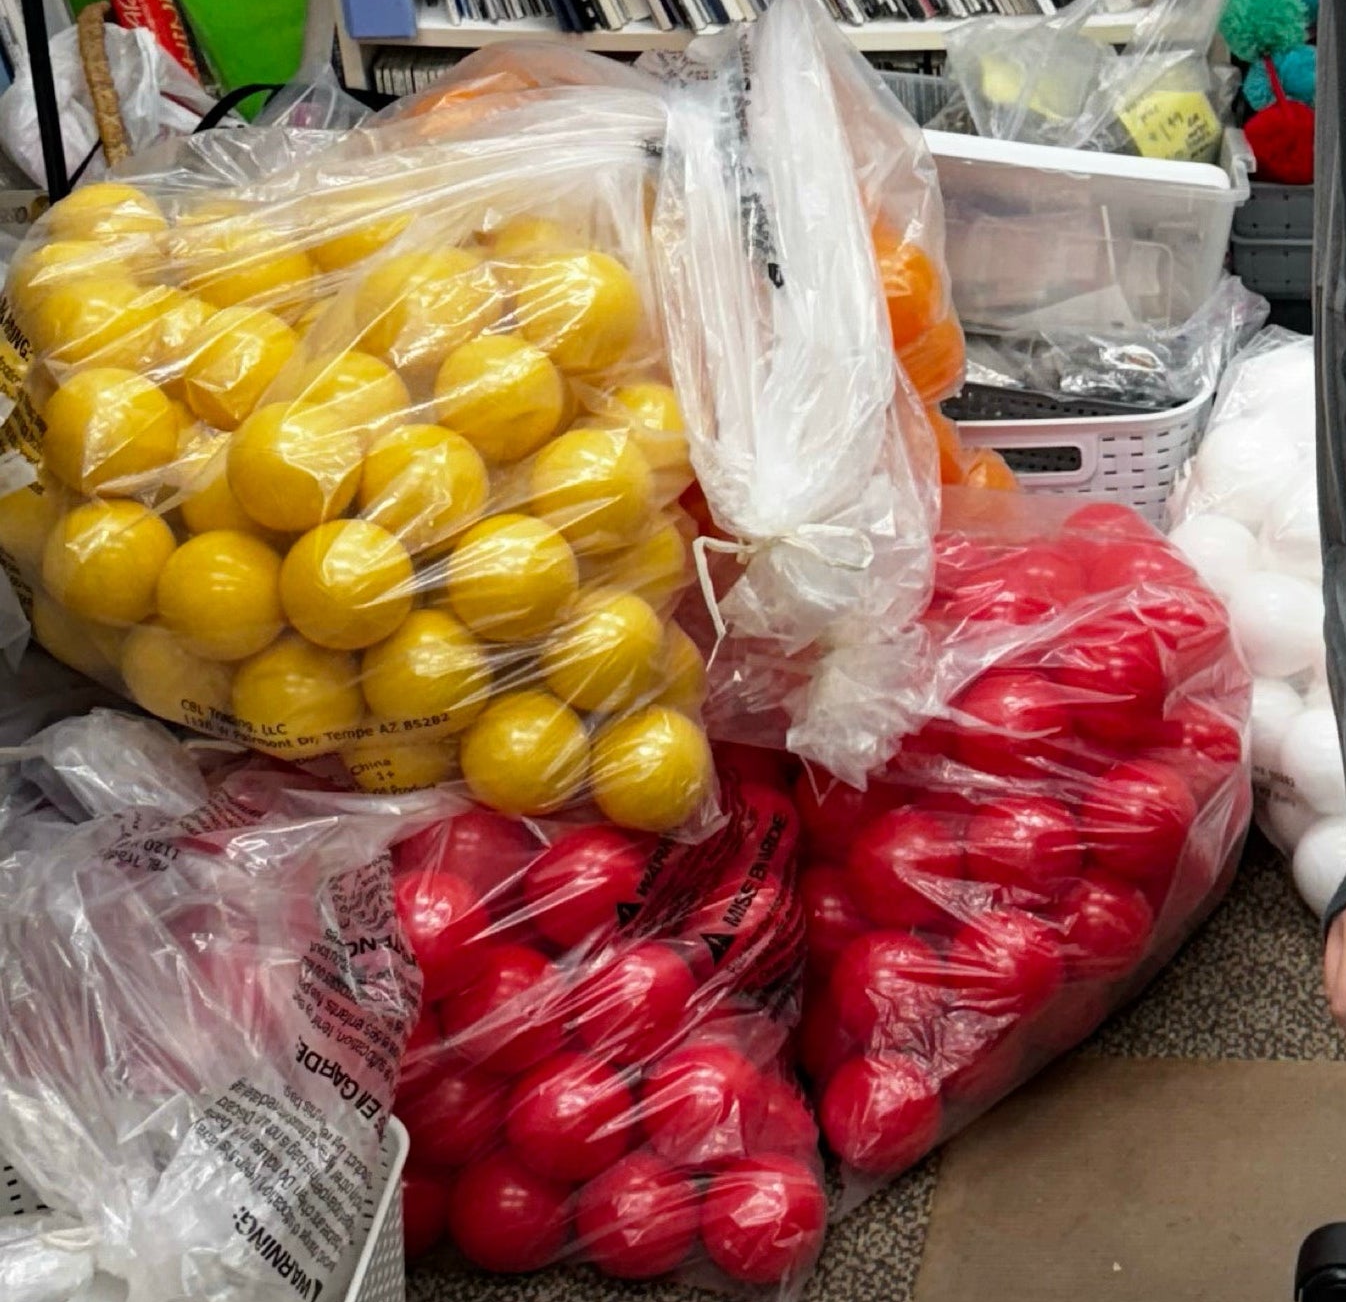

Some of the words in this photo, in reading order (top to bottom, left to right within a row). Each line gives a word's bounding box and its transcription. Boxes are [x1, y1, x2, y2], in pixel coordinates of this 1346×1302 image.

[180, 698, 206, 718] CBL
[325, 725, 375, 742] Tempe
[379, 723, 398, 735] AZ
[404, 712, 450, 732] 85282
[350, 758, 391, 776] China
[143, 839, 181, 861] 1120
[233, 1206, 314, 1298] WARNING:
